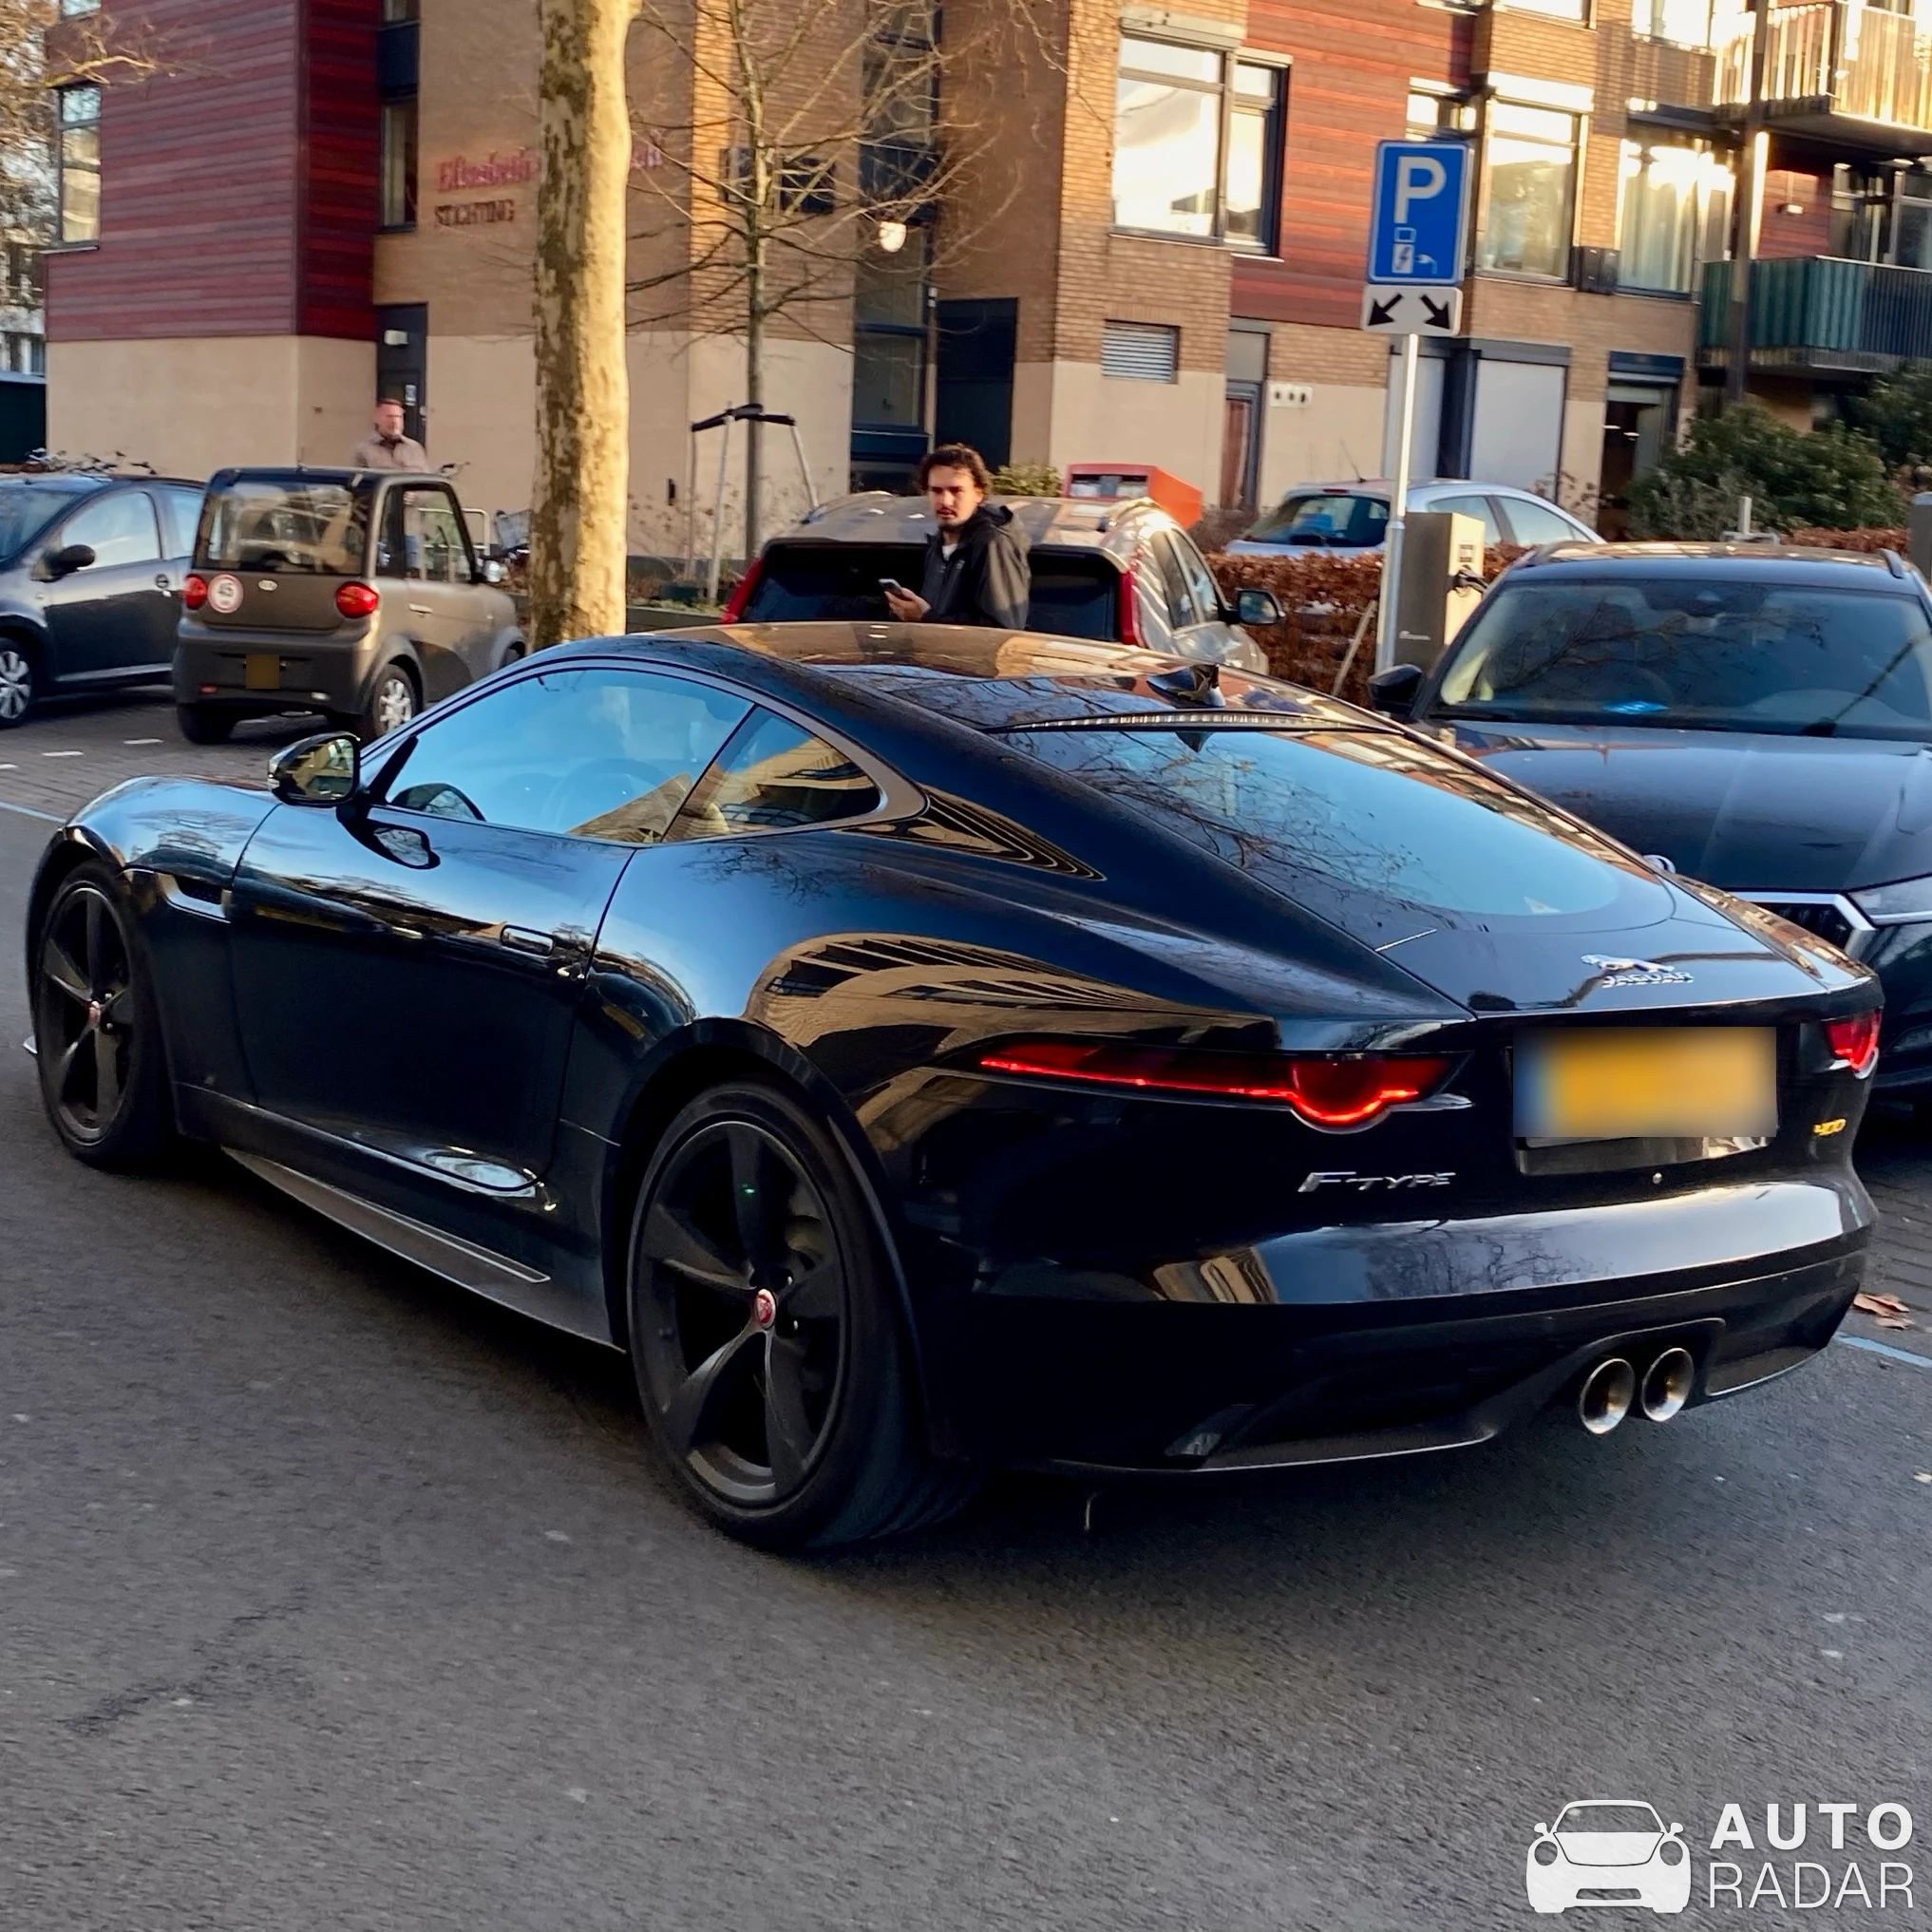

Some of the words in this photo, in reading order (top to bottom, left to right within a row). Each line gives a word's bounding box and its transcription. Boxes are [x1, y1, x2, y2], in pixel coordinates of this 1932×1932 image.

[1393, 156, 1447, 224] P
[434, 199, 515, 226] STICHTING
[1601, 971, 1695, 988] JAGUAR
[1297, 1171, 1456, 1192] F-TYPE
